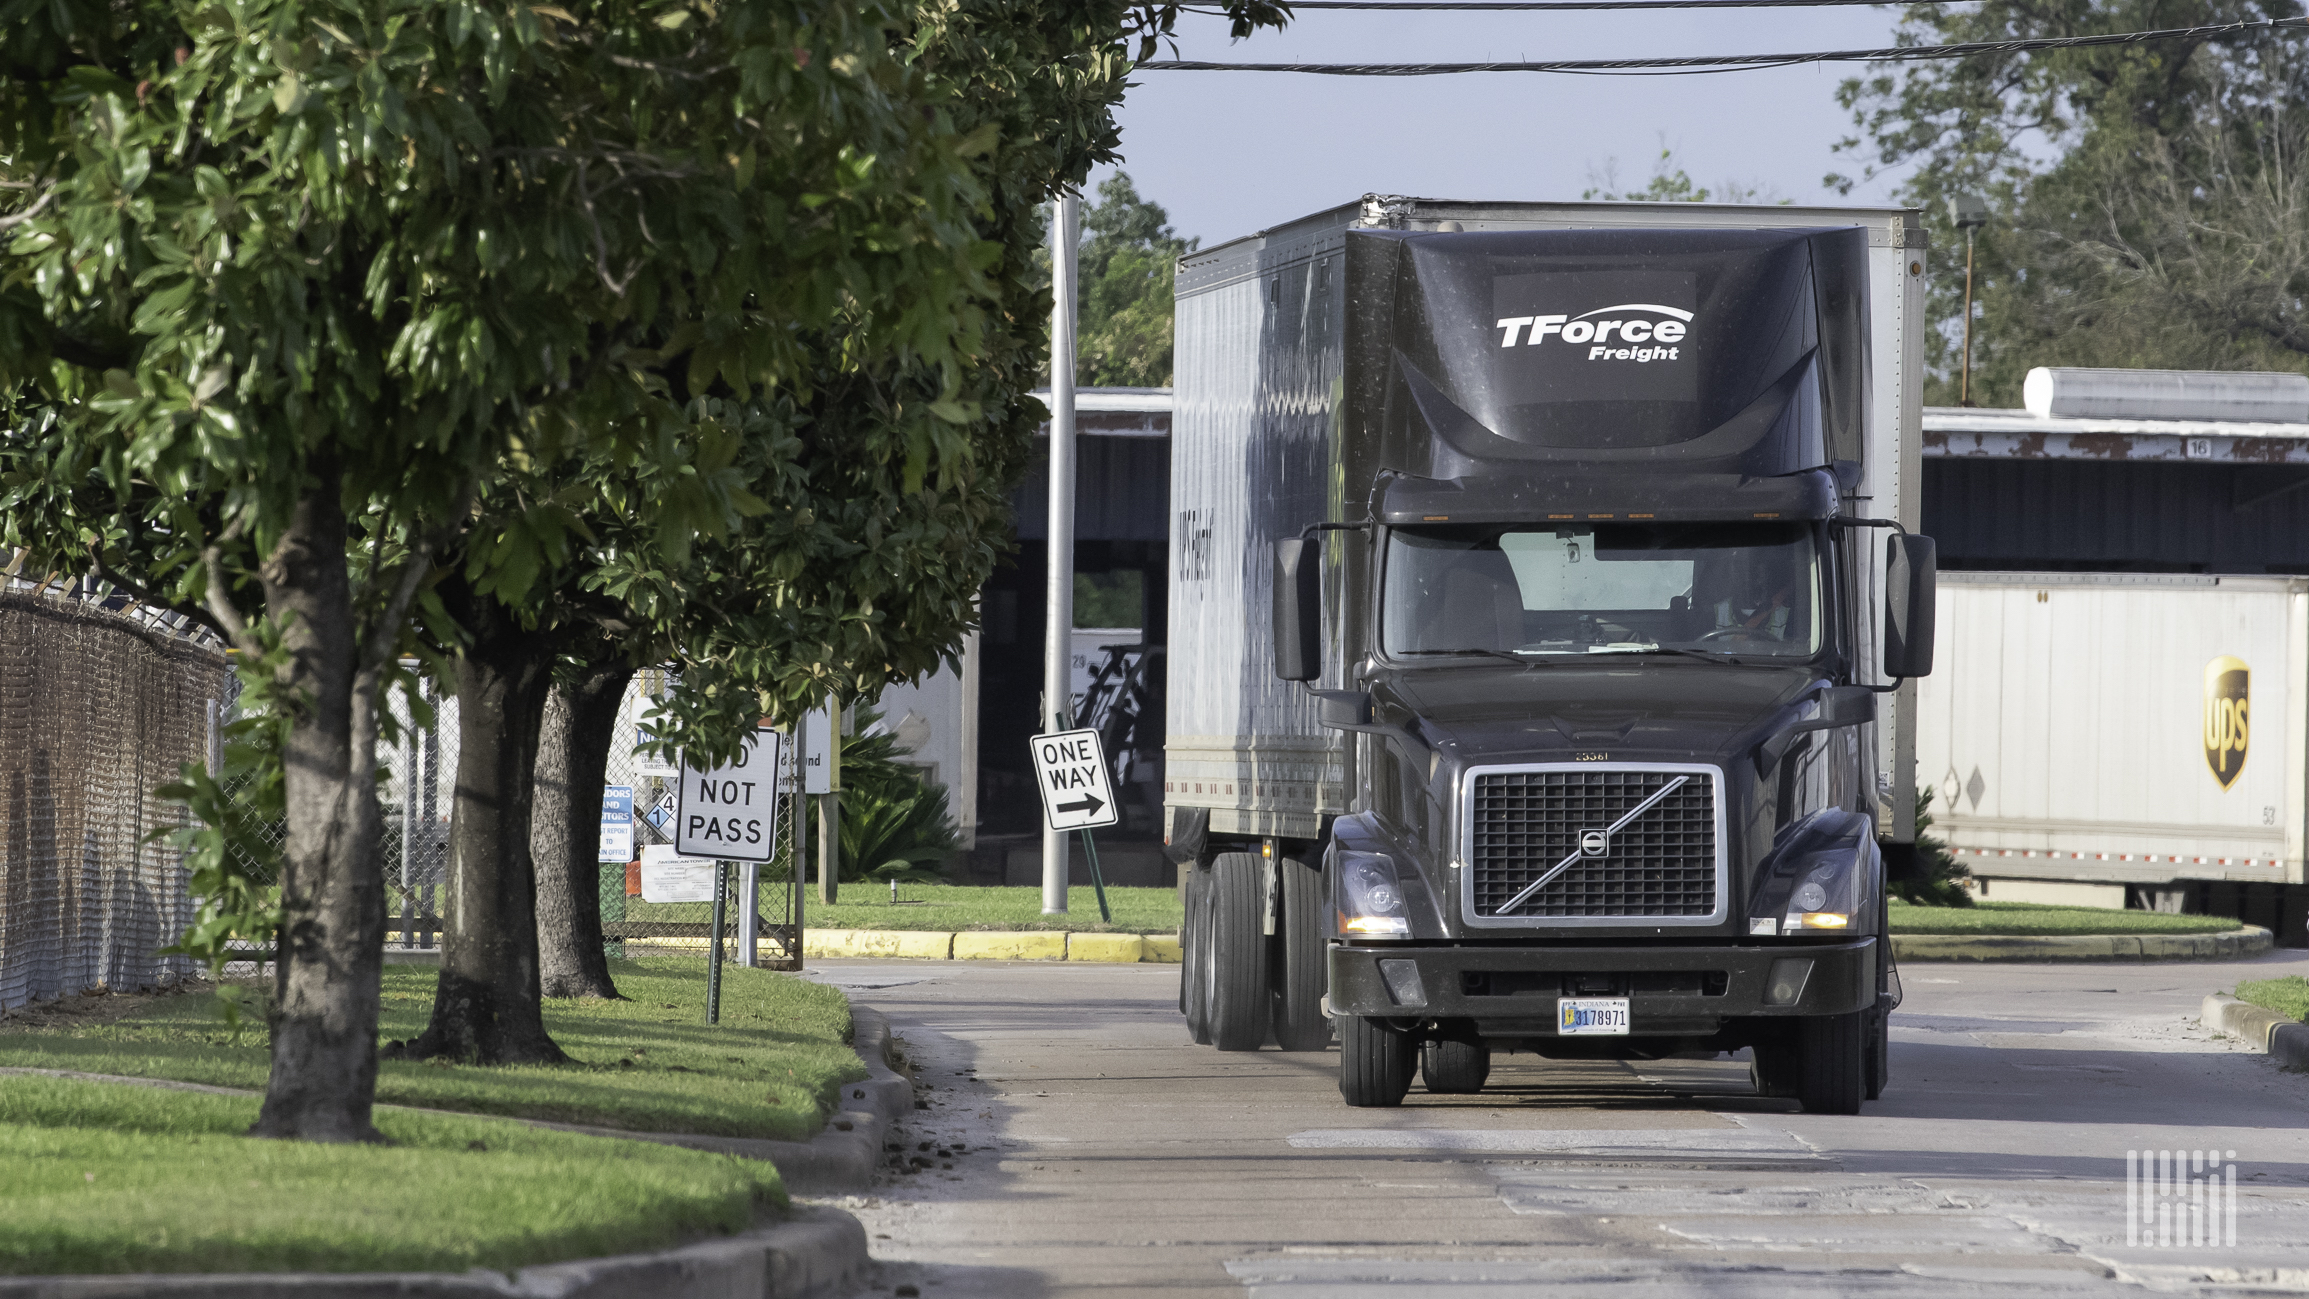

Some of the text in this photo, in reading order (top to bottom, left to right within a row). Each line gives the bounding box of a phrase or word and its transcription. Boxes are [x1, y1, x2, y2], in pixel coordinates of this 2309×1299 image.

[1496, 314, 1687, 348] TForce
[1588, 346, 1680, 363] Freight
[2191, 440, 2207, 455] 16
[1043, 739, 1093, 764] ONE
[1048, 765, 1096, 790] WAY
[700, 779, 756, 805] NOT
[663, 796, 674, 811] 4
[652, 809, 660, 825] 1
[689, 815, 761, 844] PASS
[1576, 1010, 1626, 1025] 3178971
